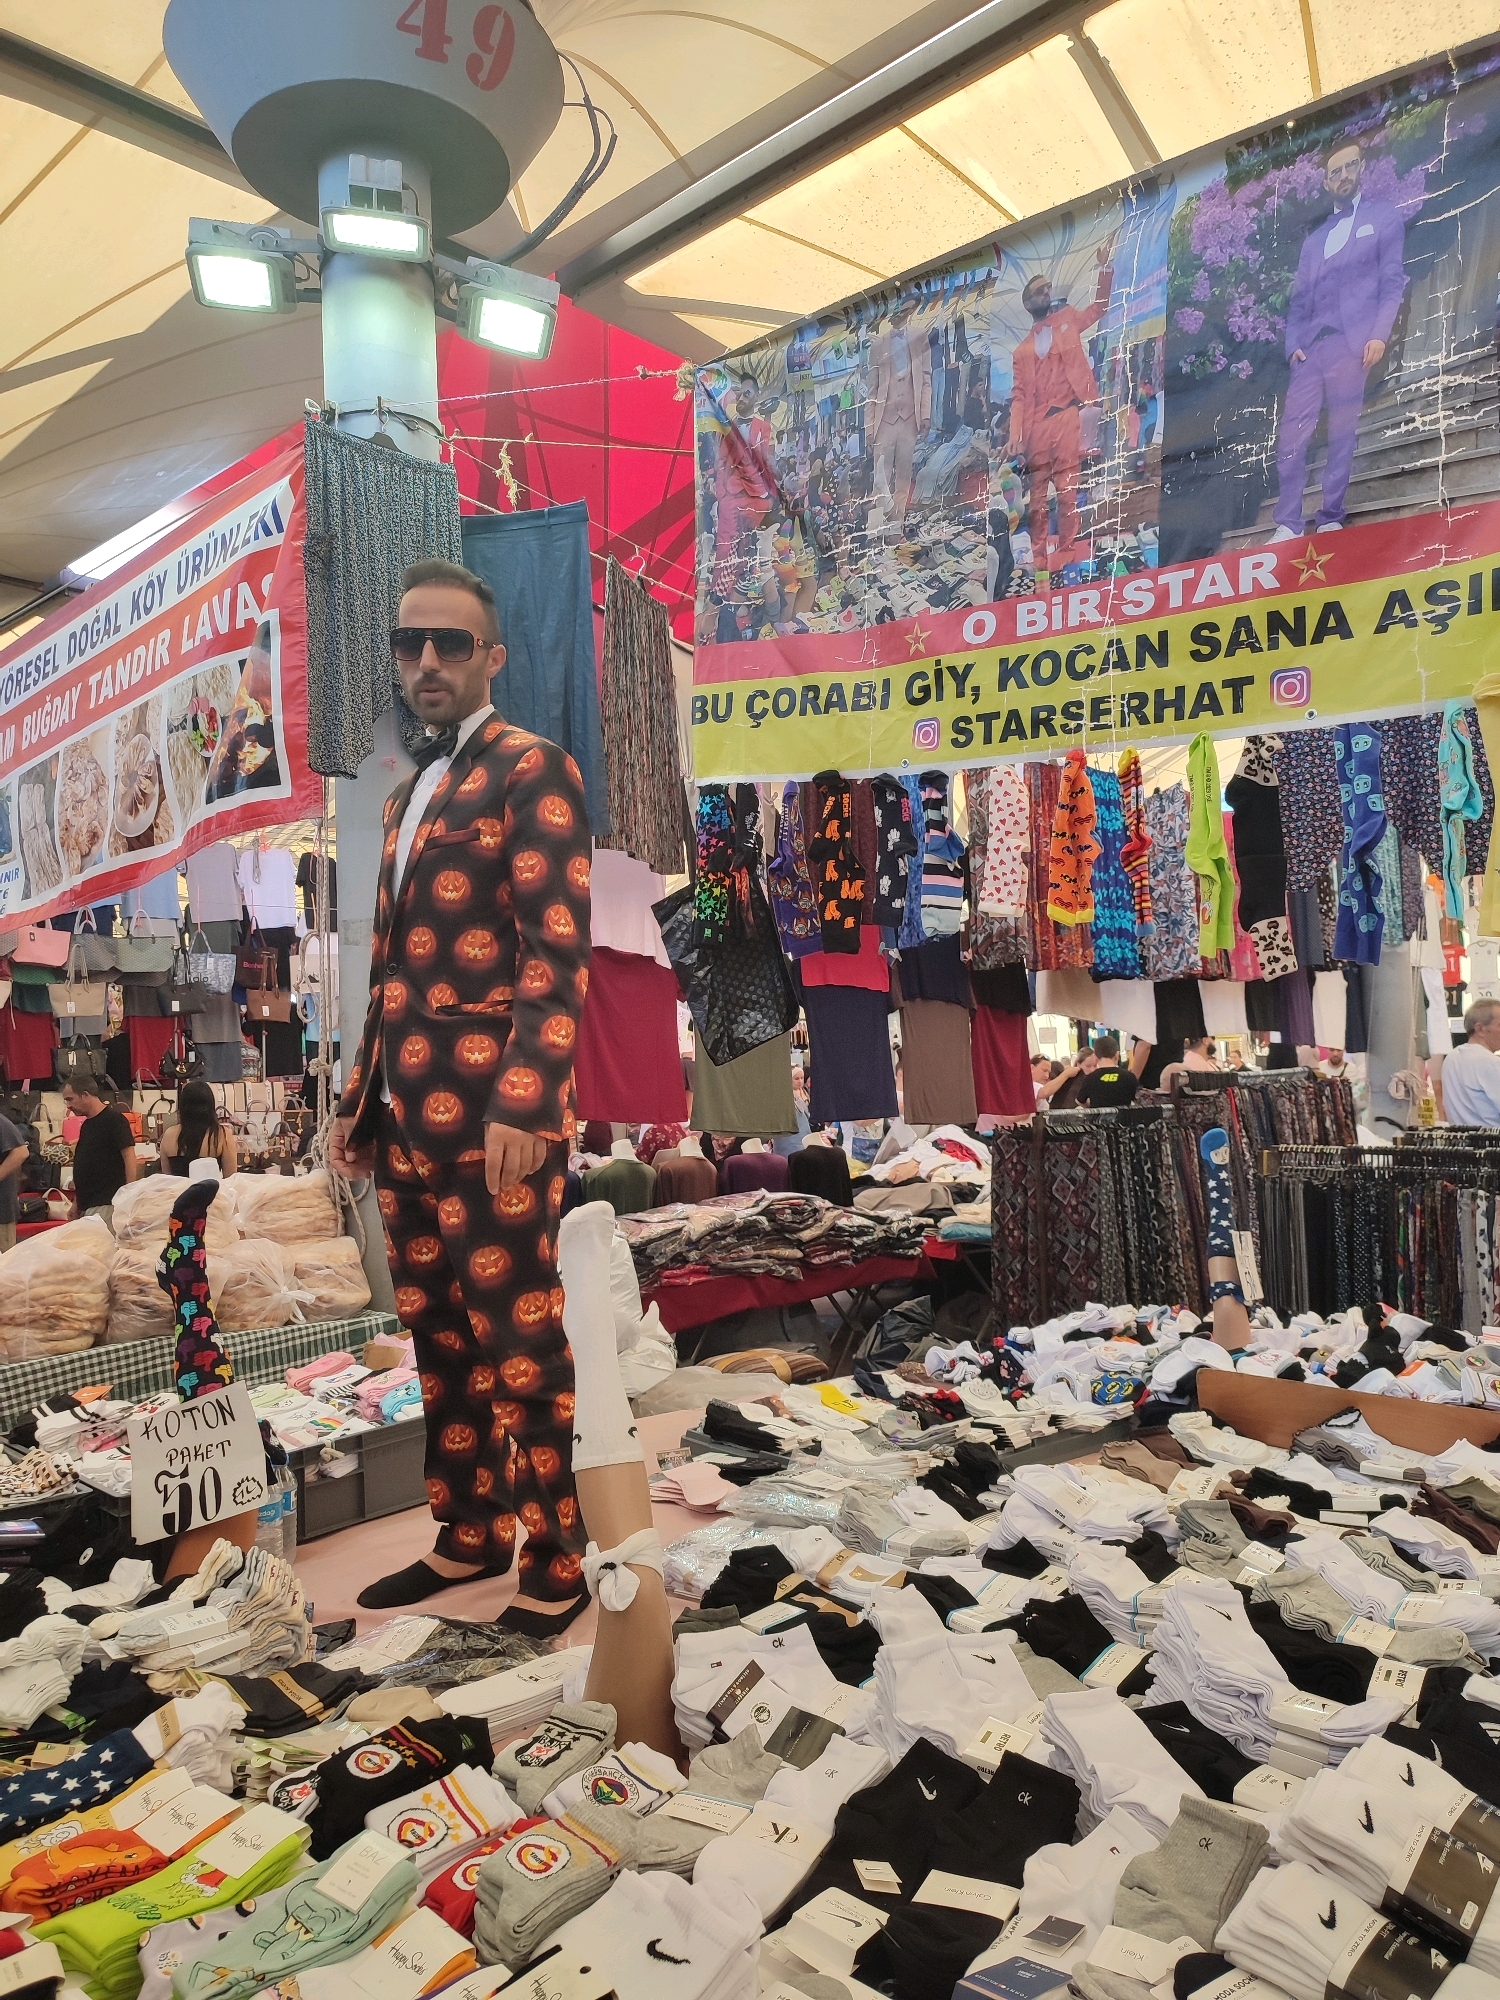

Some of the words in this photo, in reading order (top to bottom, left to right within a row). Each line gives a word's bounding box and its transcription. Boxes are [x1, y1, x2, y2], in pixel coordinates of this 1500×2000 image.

[396, 0, 515, 91] 49
[963, 610, 997, 645] O
[1121, 552, 1281, 616] STAR
[67, 602, 122, 666] DOĞAL
[129, 569, 169, 627] KÖY
[692, 692, 733, 725] BU
[745, 677, 890, 728] ÇORABI
[905, 658, 980, 706] GİY,
[997, 630, 1168, 692] KOCAN
[1189, 600, 1354, 663] SANA
[22, 683, 82, 750] BUĞDAY
[89, 628, 171, 710] TANDIR
[950, 675, 1255, 749] STARSERHAT
[822, 795, 836, 819] SOCKS
[842, 793, 850, 818] SOCKS
[901, 797, 910, 822] SOCKS
[721, 809, 729, 830] SOCKS
[1100, 1073, 1119, 1082] 46
[140, 1395, 236, 1443] KOTON
[166, 1440, 232, 1467] PAKET
[154, 1463, 222, 1535] 50
[772, 1637, 786, 1649] CK
[994, 1732, 1011, 1752] RETRO
[825, 1768, 839, 1779] CK
[976, 1765, 995, 1776] RETRO
[1018, 1791, 1032, 1806] CK
[168, 1803, 184, 1825] Happy
[180, 1812, 198, 1831] Socks
[229, 1827, 248, 1849] Happy
[244, 1834, 265, 1851] Socks
[1198, 1837, 1213, 1851] CK
[944, 1886, 966, 1897] Klein
[965, 1890, 992, 1902] Calvin
[1364, 1918, 1379, 1934] MOVE
[388, 1938, 408, 1970] Happy
[405, 1951, 429, 1976] Socks
[1121, 1947, 1145, 1961] Klein
[1347, 1941, 1361, 1958] ZERO
[1213, 1985, 1236, 2000] MODA
